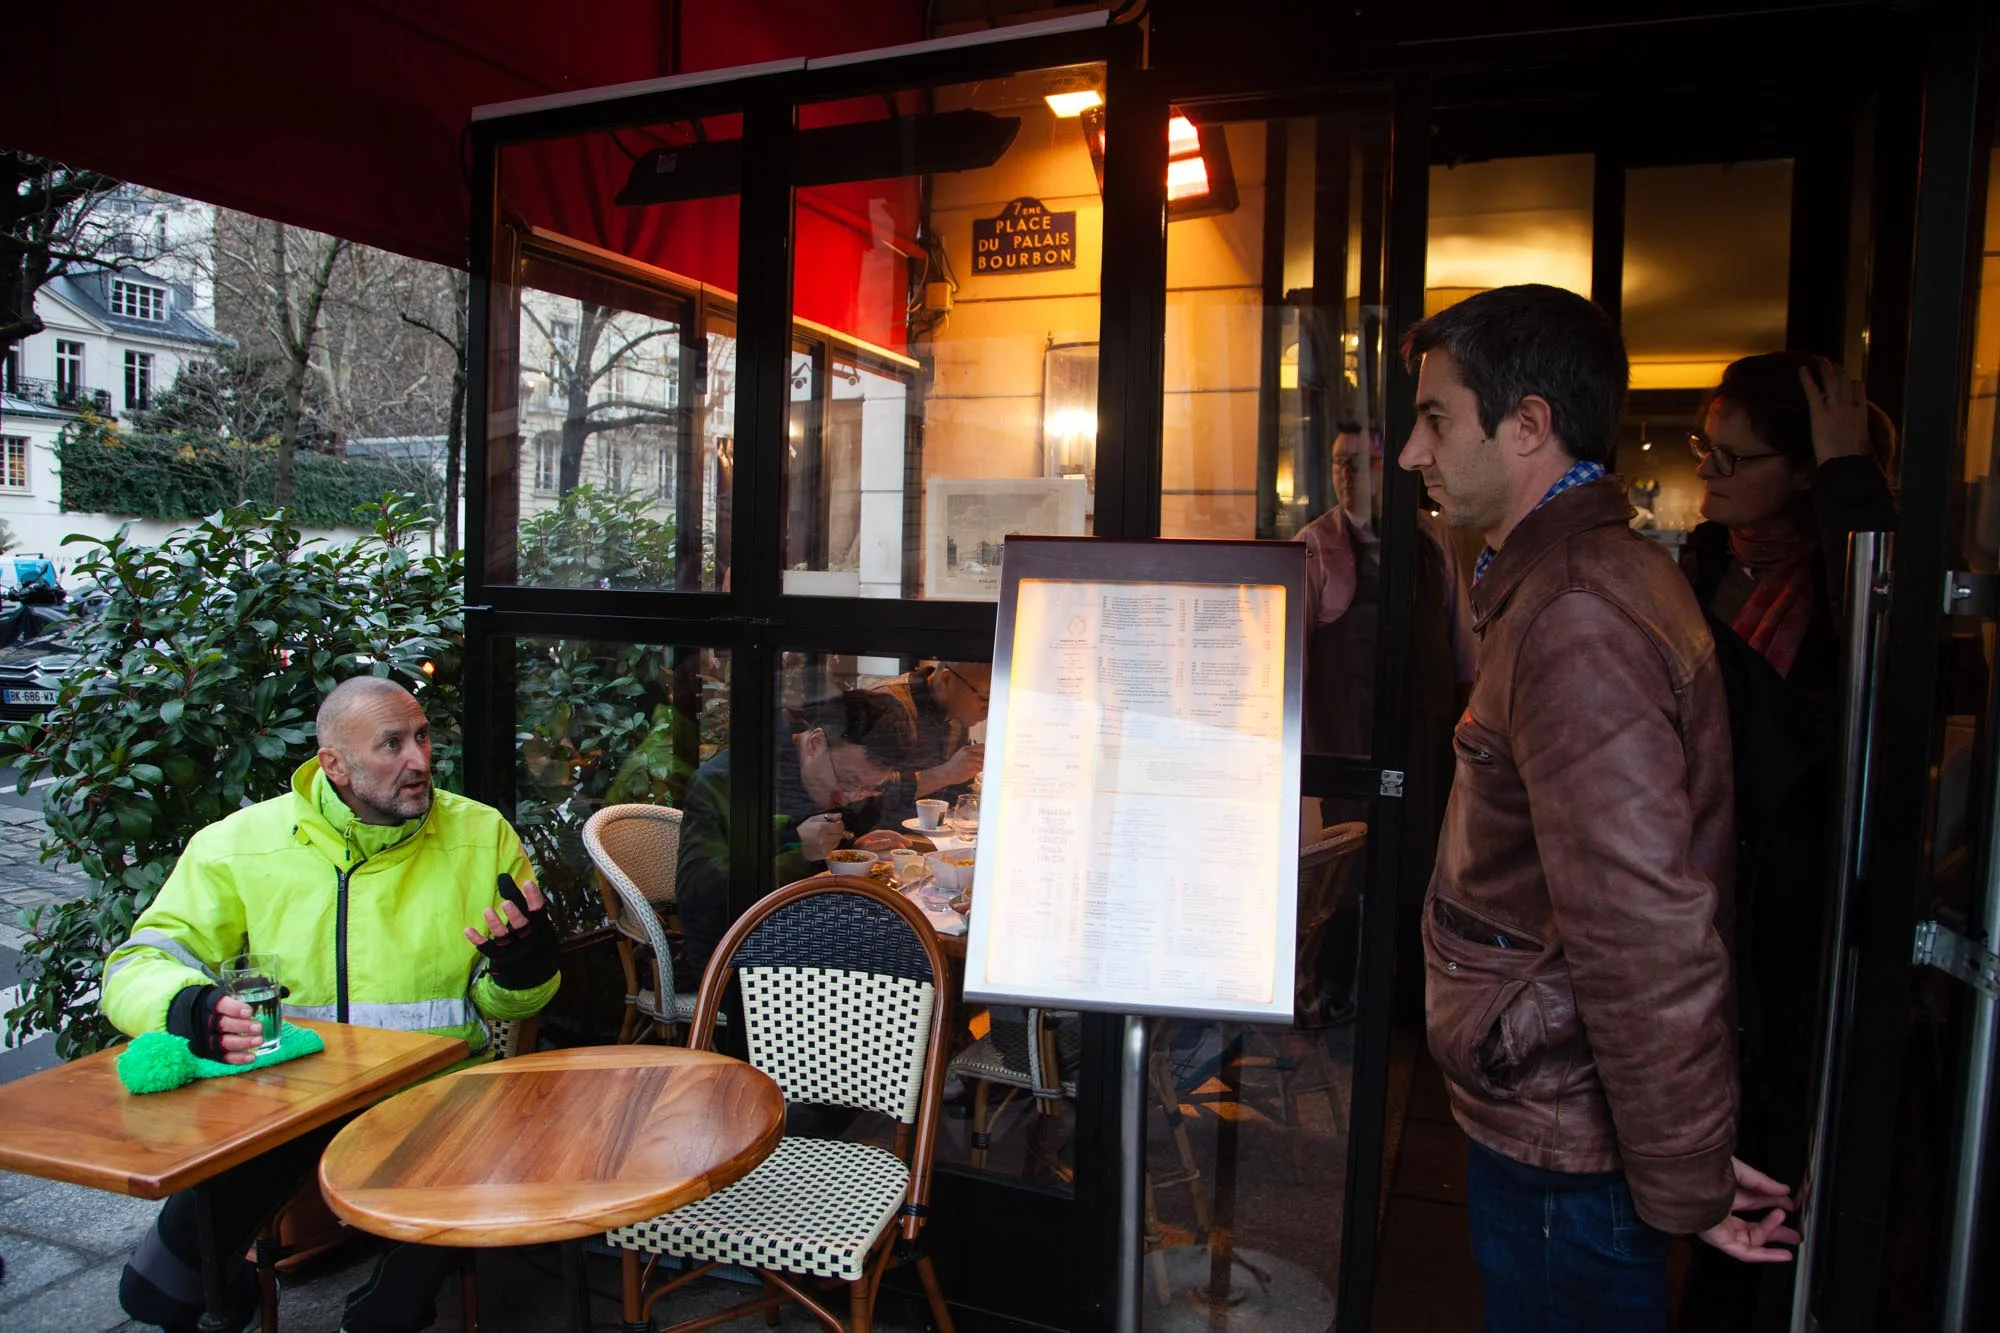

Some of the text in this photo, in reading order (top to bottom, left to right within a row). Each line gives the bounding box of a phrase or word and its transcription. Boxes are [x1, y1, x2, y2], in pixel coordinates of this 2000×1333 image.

[996, 216, 1051, 233] PLACE
[978, 232, 1069, 252] DU PALAIS
[978, 249, 1071, 269] BOURBON
